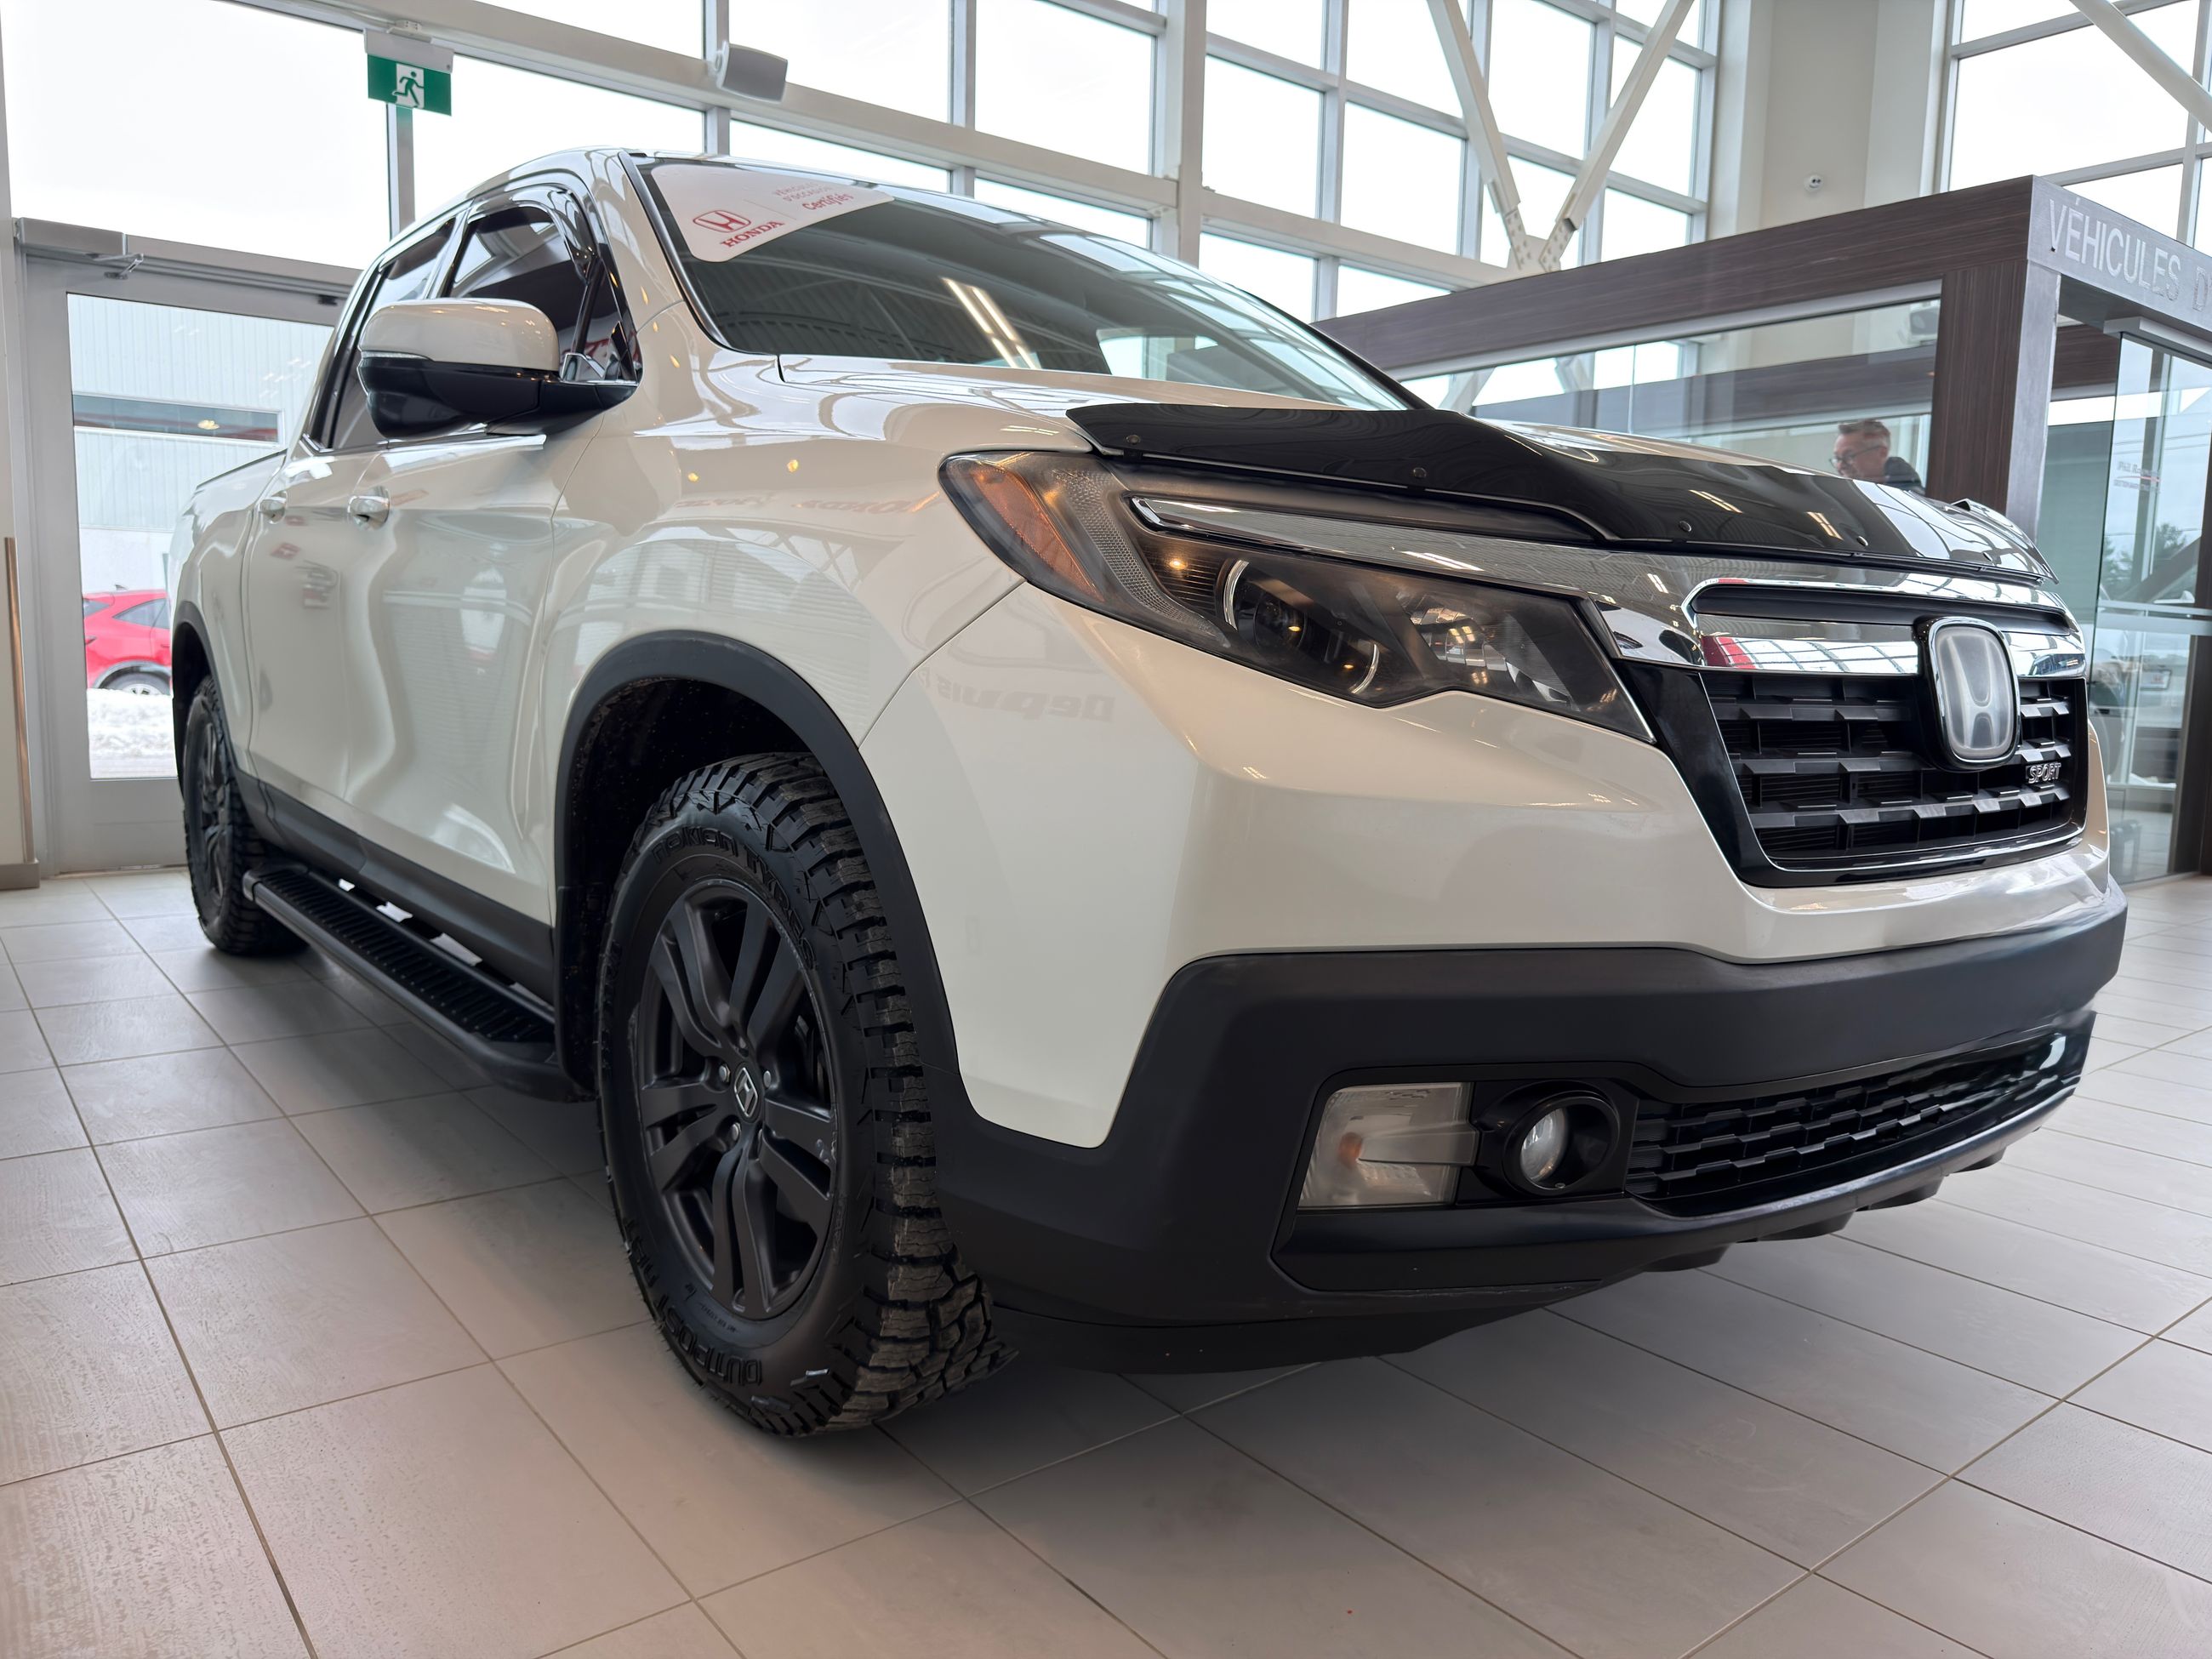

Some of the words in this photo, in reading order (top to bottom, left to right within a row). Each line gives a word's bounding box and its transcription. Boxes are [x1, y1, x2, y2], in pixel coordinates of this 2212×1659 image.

[720, 220, 785, 248] HONDA
[2050, 197, 2181, 301] VÉHICULES
[2028, 762, 2061, 784] SPORT
[654, 1293, 763, 1387] OUTPOST
